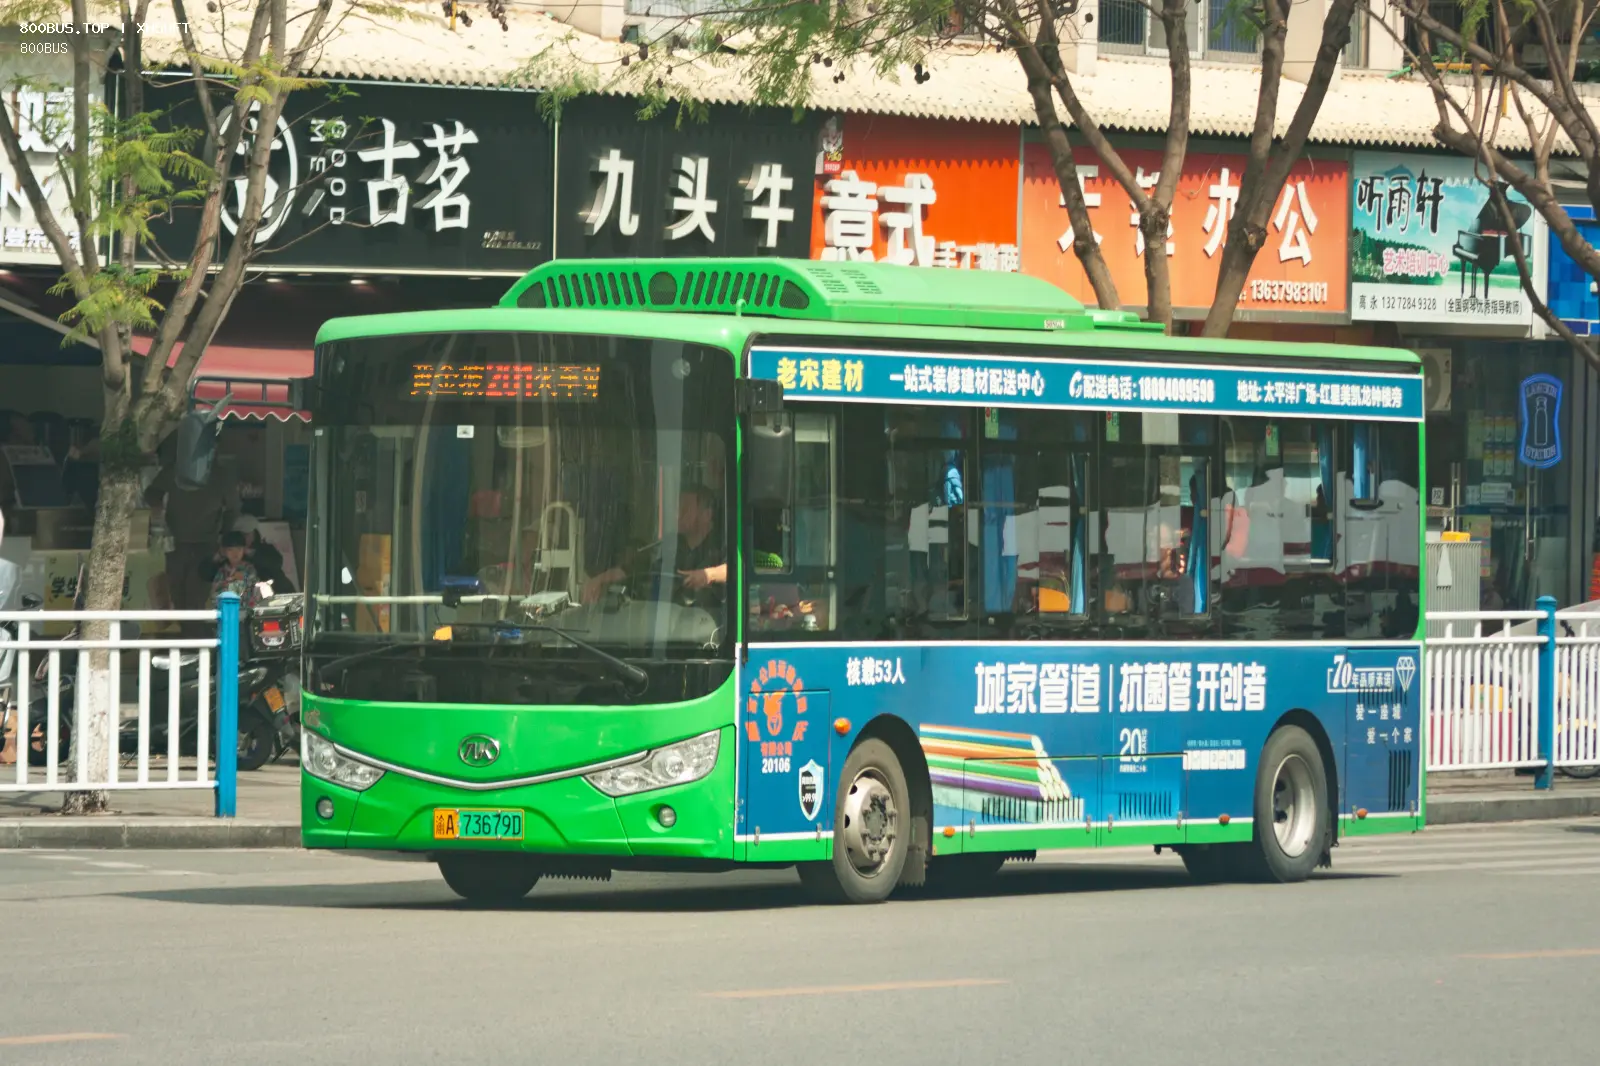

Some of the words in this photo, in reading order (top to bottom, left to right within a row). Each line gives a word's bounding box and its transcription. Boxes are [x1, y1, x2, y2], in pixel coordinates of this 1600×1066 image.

[357, 117, 479, 232] 古茗
[584, 149, 794, 247] 九头牛
[1357, 168, 1445, 234] 听雨轩
[822, 170, 937, 267] 意式
[1383, 248, 1449, 276] 艺术培训中心
[776, 356, 865, 392] 老宋建材
[889, 364, 1045, 397] 一站式装修建材配送中心
[846, 656, 906, 686] 核载53人
[974, 661, 1101, 714] 城家管道
[1119, 727, 1142, 763] 20
[762, 757, 791, 774] 20106
